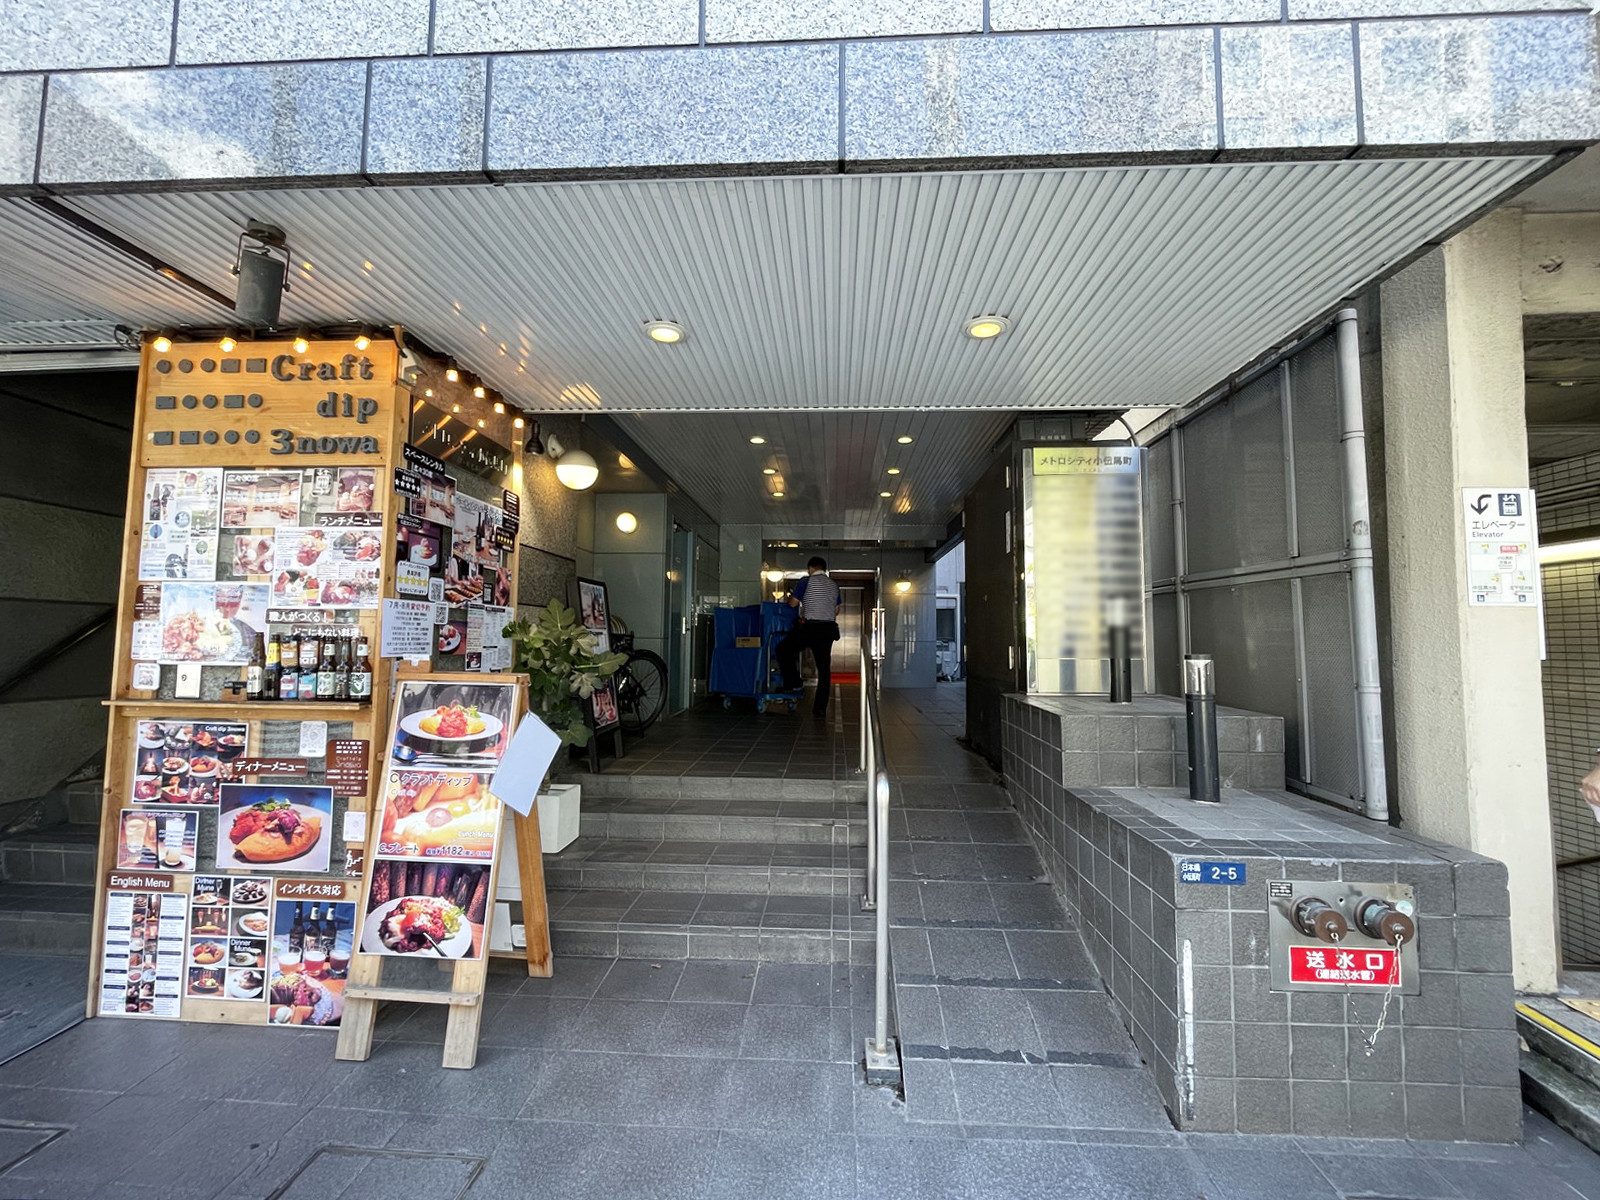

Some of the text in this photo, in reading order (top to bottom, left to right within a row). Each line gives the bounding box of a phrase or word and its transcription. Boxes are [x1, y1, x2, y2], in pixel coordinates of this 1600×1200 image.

[270, 353, 375, 382] Craft
[316, 391, 378, 424] dip
[269, 428, 380, 455] 3nowa
[1040, 455, 1133, 467] メトロシティ小伝馬町
[319, 515, 382, 527] ランチメニュー
[1471, 520, 1526, 530] エレベーター
[235, 760, 306, 772] ディナーメニュー
[1211, 866, 1237, 880] 2-5
[110, 875, 170, 888] English Menu
[195, 877, 215, 885] Dinner
[279, 882, 342, 896] インボイス対応
[230, 938, 251, 947] Dinner
[1305, 950, 1385, 970] 送水口
